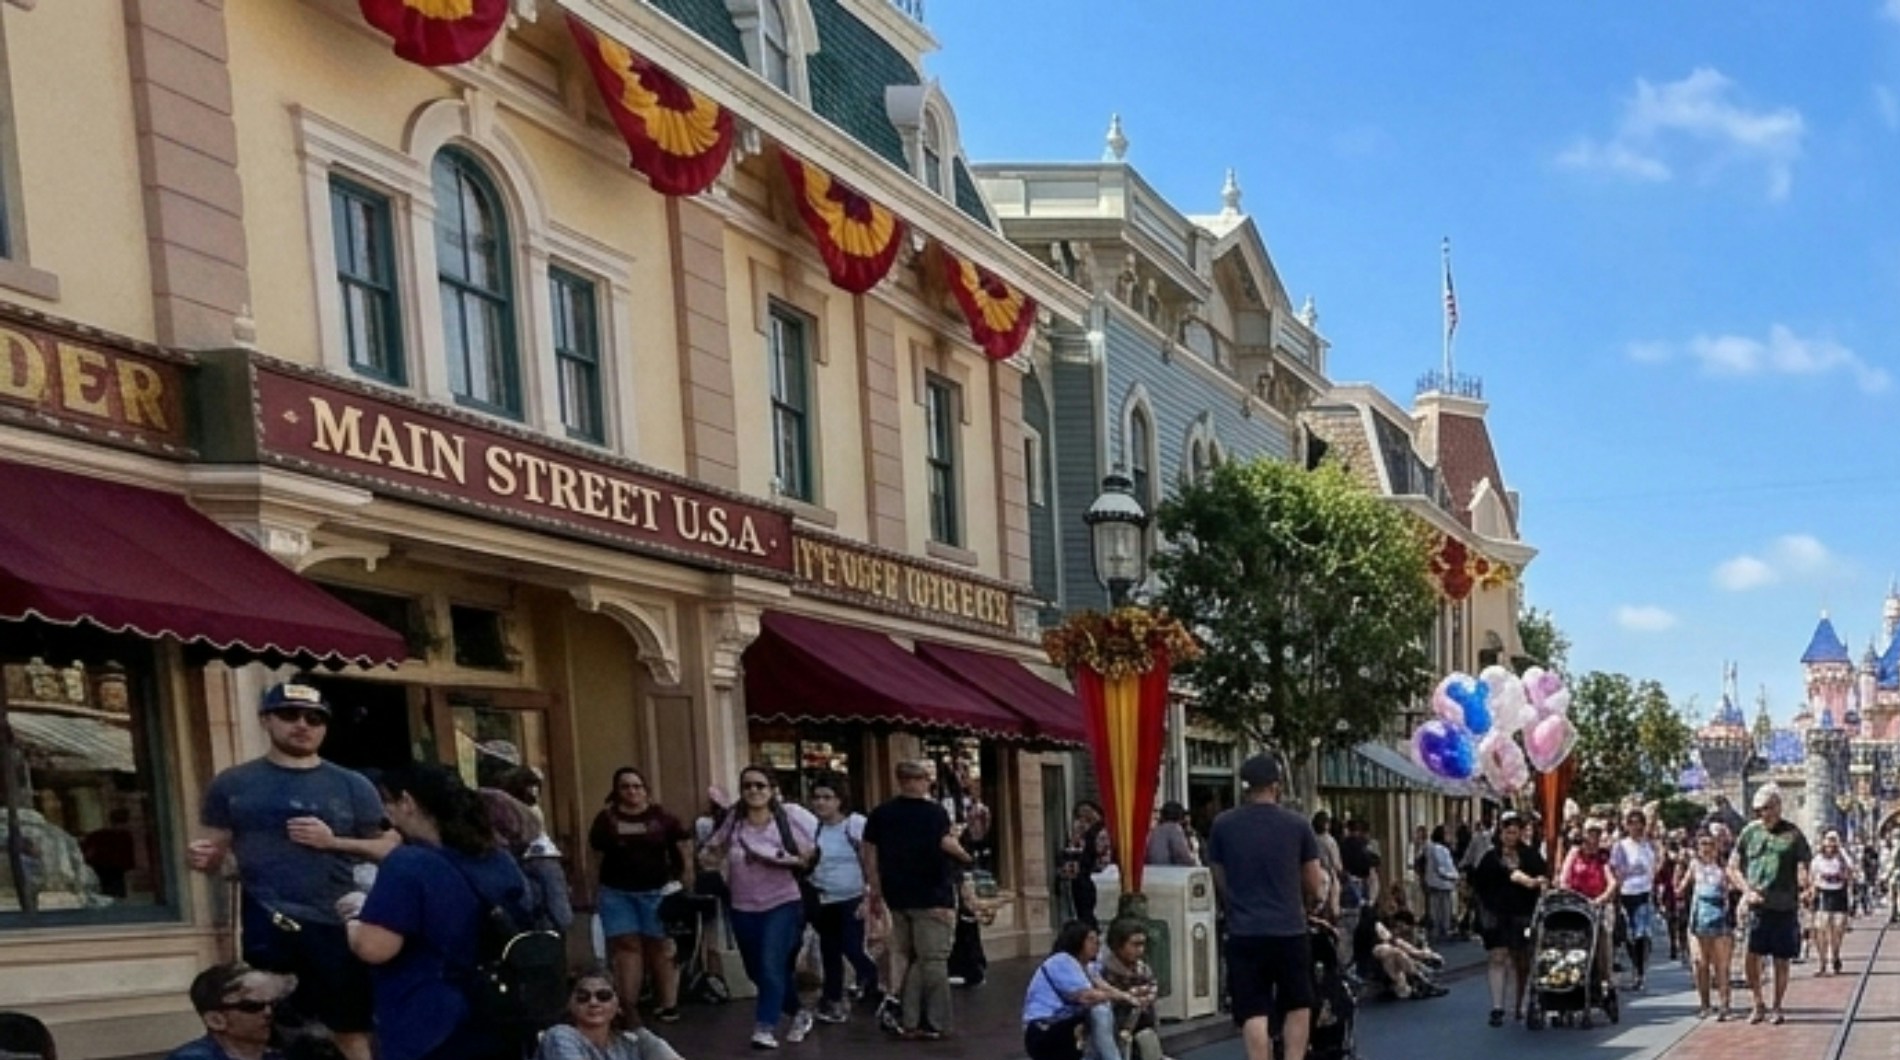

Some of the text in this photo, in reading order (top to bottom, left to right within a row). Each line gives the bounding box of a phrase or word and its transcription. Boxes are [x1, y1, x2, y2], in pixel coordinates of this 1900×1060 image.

[0, 328, 168, 431] DER
[309, 396, 466, 484] MAIN
[485, 445, 661, 531] STREET
